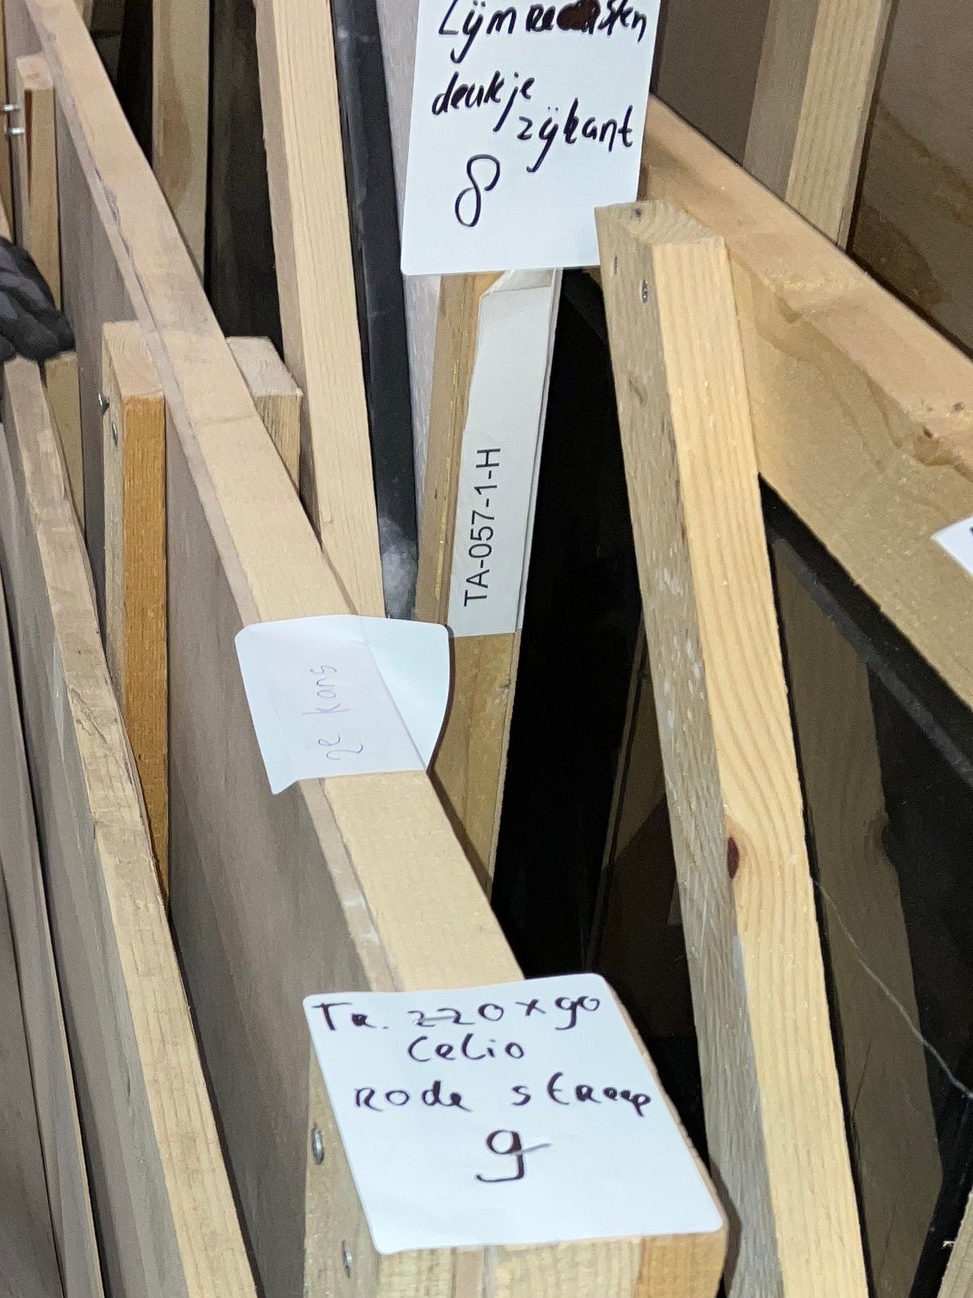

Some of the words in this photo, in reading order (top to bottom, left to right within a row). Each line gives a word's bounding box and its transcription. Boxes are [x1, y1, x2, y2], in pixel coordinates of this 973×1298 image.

[454, 153, 501, 228] 8
[463, 448, 502, 608] TA-057-1-H
[407, 1033, 525, 1062] Celio
